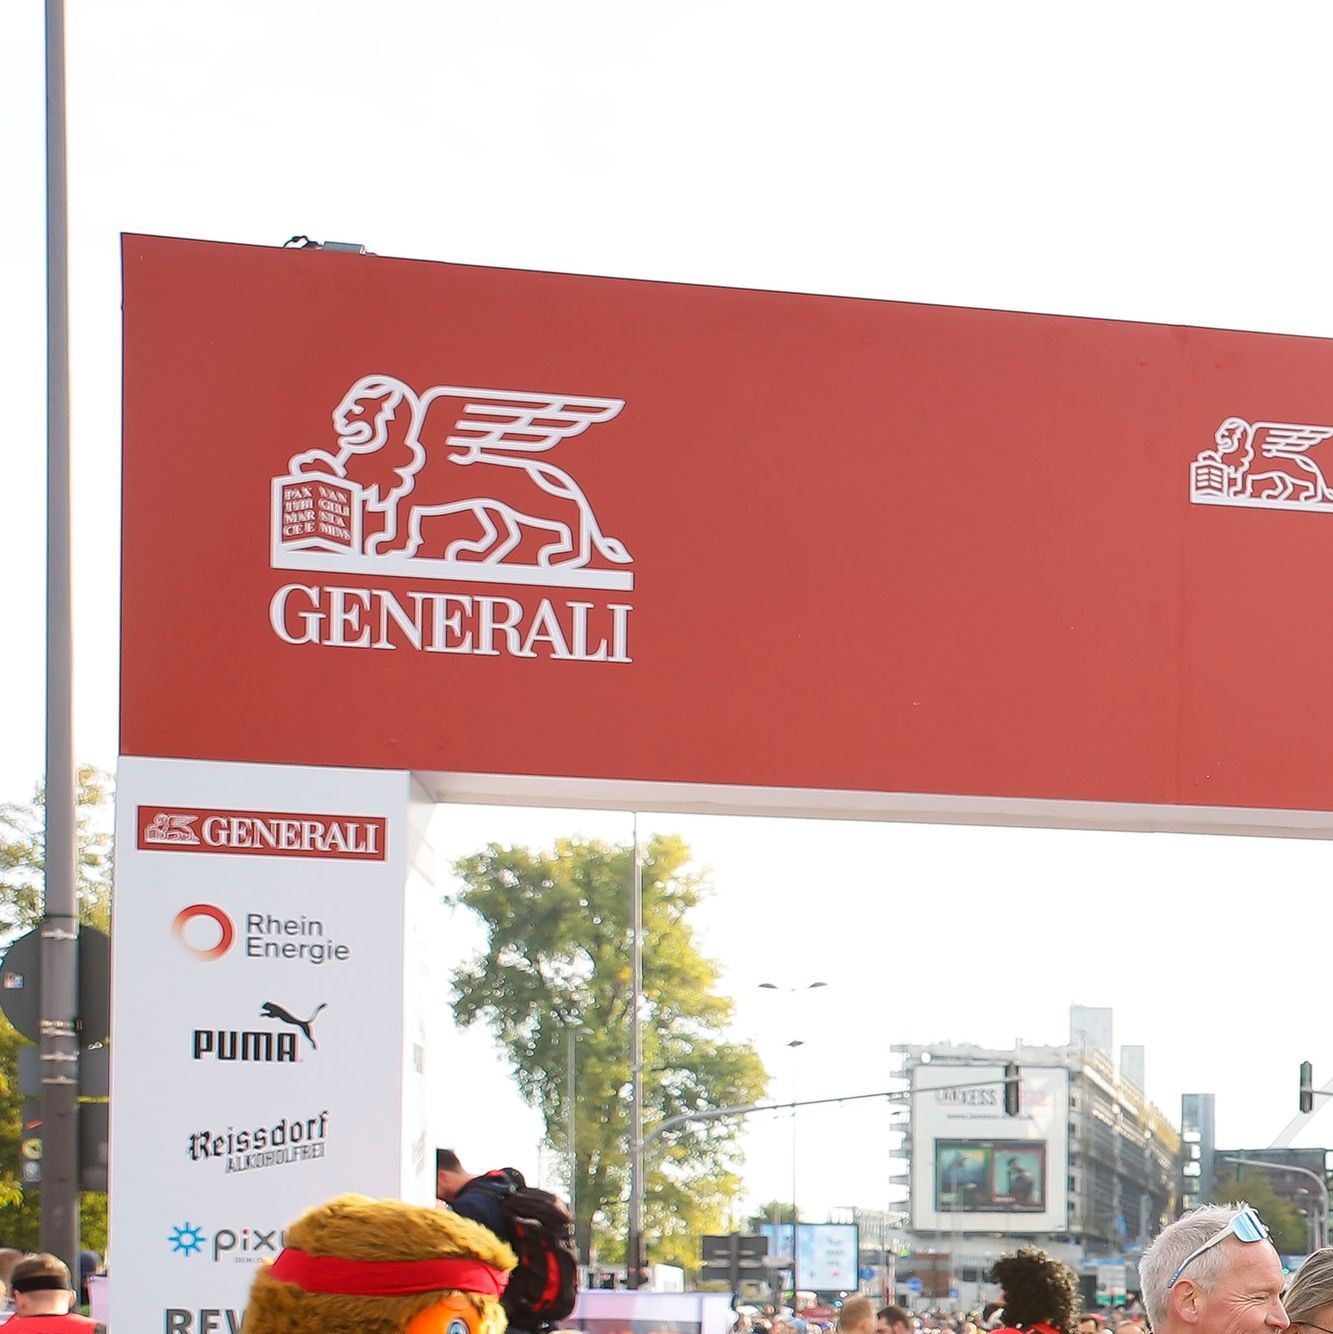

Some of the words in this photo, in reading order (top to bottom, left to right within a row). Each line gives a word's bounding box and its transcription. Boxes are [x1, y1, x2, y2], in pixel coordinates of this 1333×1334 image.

[268, 583, 634, 663] GENERALI
[201, 815, 380, 854] GENERALI
[246, 913, 323, 936] Rhein
[246, 937, 350, 964] Energie
[193, 1029, 297, 1062] PUMA
[187, 1110, 331, 1161] Reissdorf
[225, 1142, 326, 1173] ALKOHOLFREI
